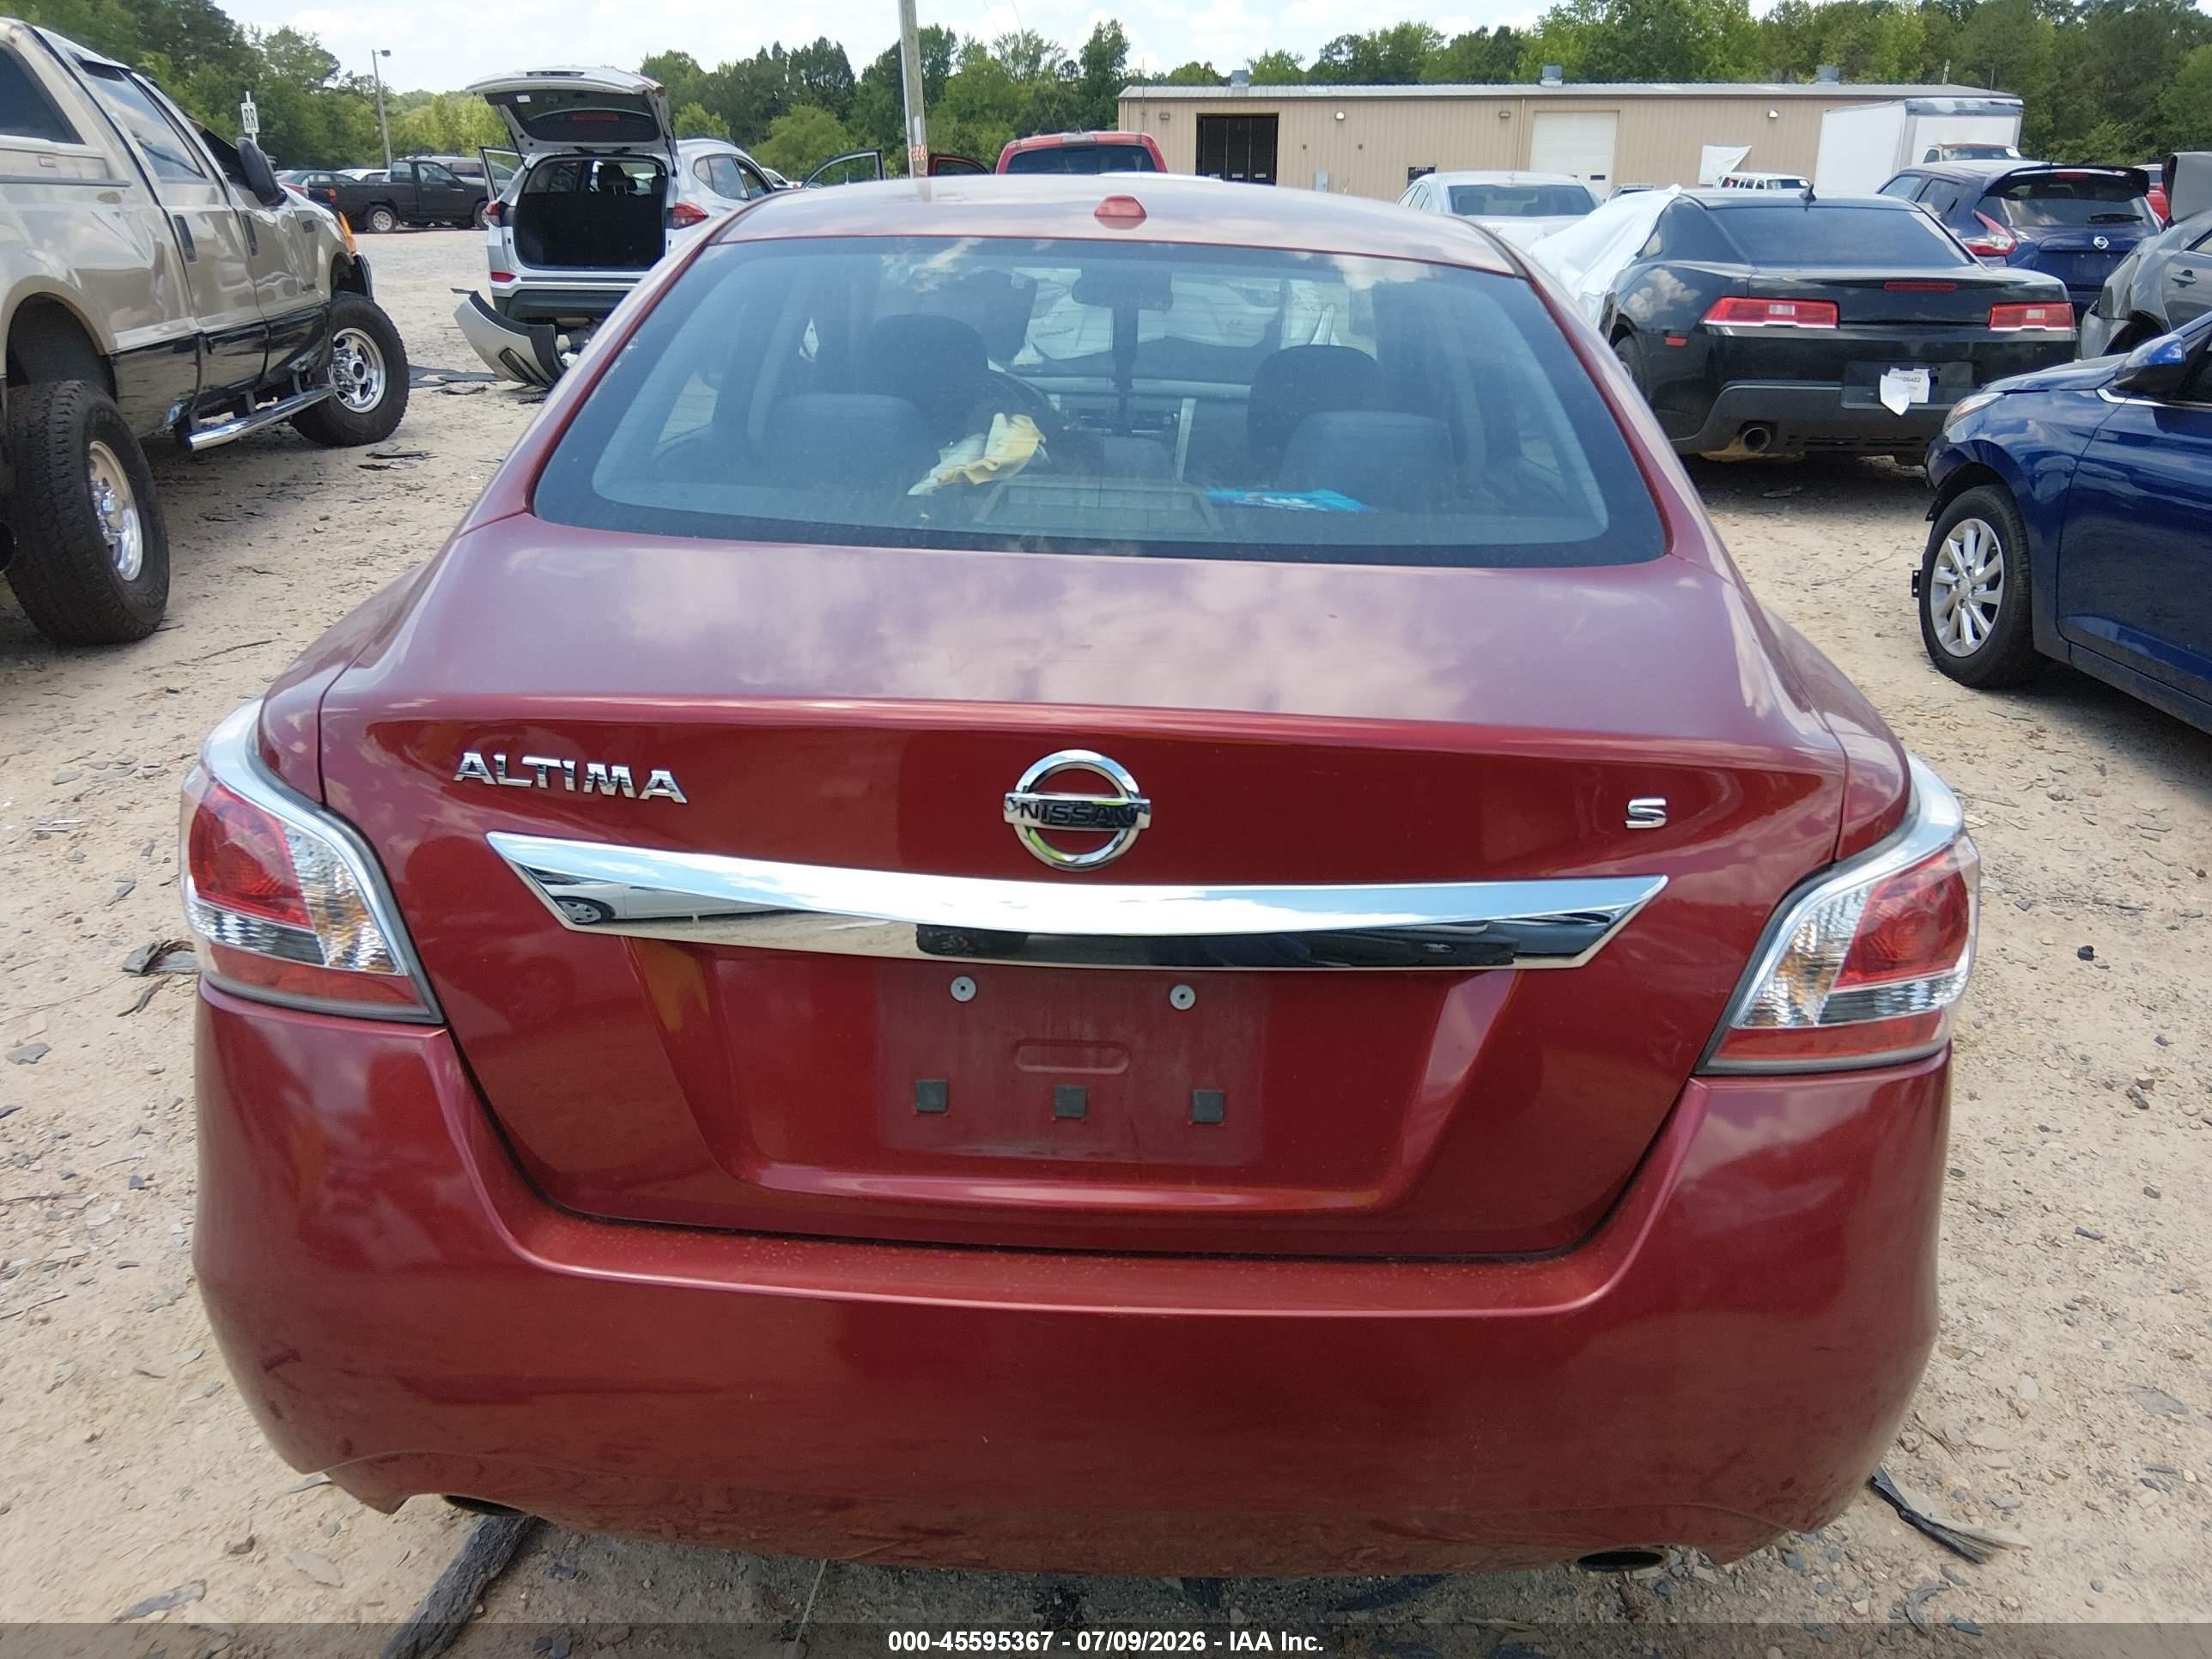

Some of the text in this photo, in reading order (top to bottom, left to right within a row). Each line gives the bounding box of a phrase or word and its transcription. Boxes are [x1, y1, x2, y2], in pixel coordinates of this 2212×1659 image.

[453, 752, 688, 805] ALTIMA
[1019, 801, 1139, 828] NISSAN
[1625, 798, 1668, 830] S
